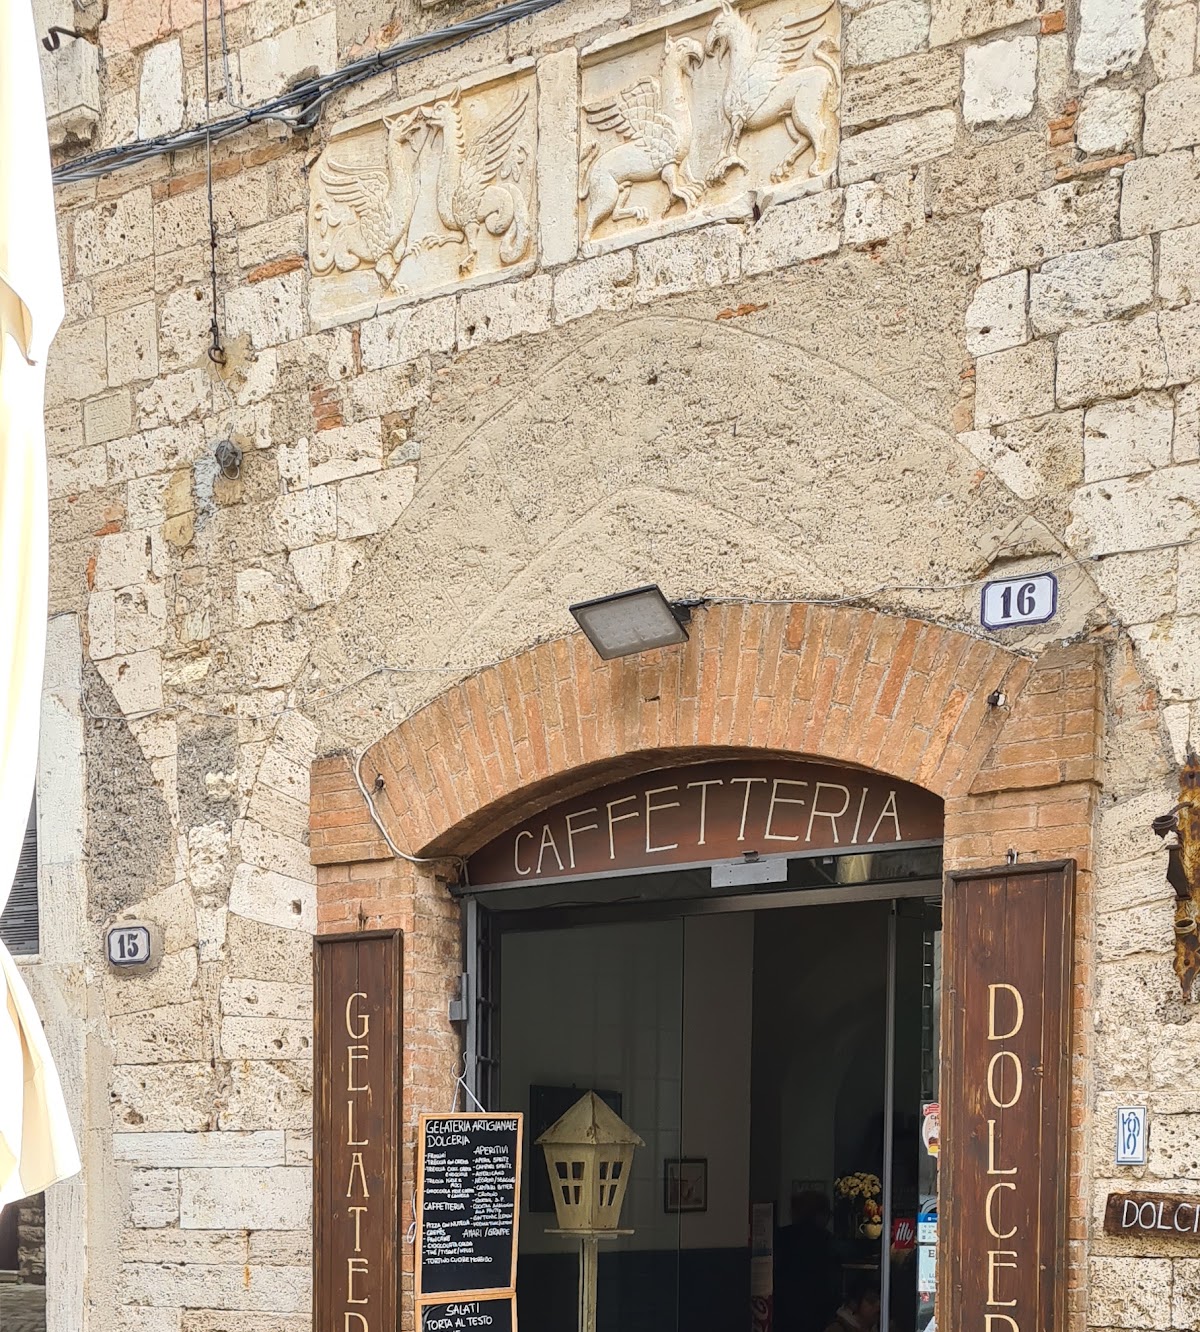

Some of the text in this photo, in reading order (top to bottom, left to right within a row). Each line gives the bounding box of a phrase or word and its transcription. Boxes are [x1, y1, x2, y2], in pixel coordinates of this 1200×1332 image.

[1000, 583, 1036, 619] 16
[514, 777, 902, 876] CAFFETTERIA
[118, 933, 139, 959] 15
[426, 1120, 517, 1134] GELATERIA ARTIGIANALE
[427, 1135, 470, 1147] DOLCERIA
[473, 1145, 509, 1155] APERITIVI
[423, 1202, 465, 1211] CAFFETTERIA
[1122, 1199, 1200, 1233] DOLCI
[462, 1229, 482, 1238] AMARI
[896, 1222, 914, 1245] illy
[445, 1302, 480, 1316] SALATI
[426, 1315, 493, 1331] TORTA AL TESTO
